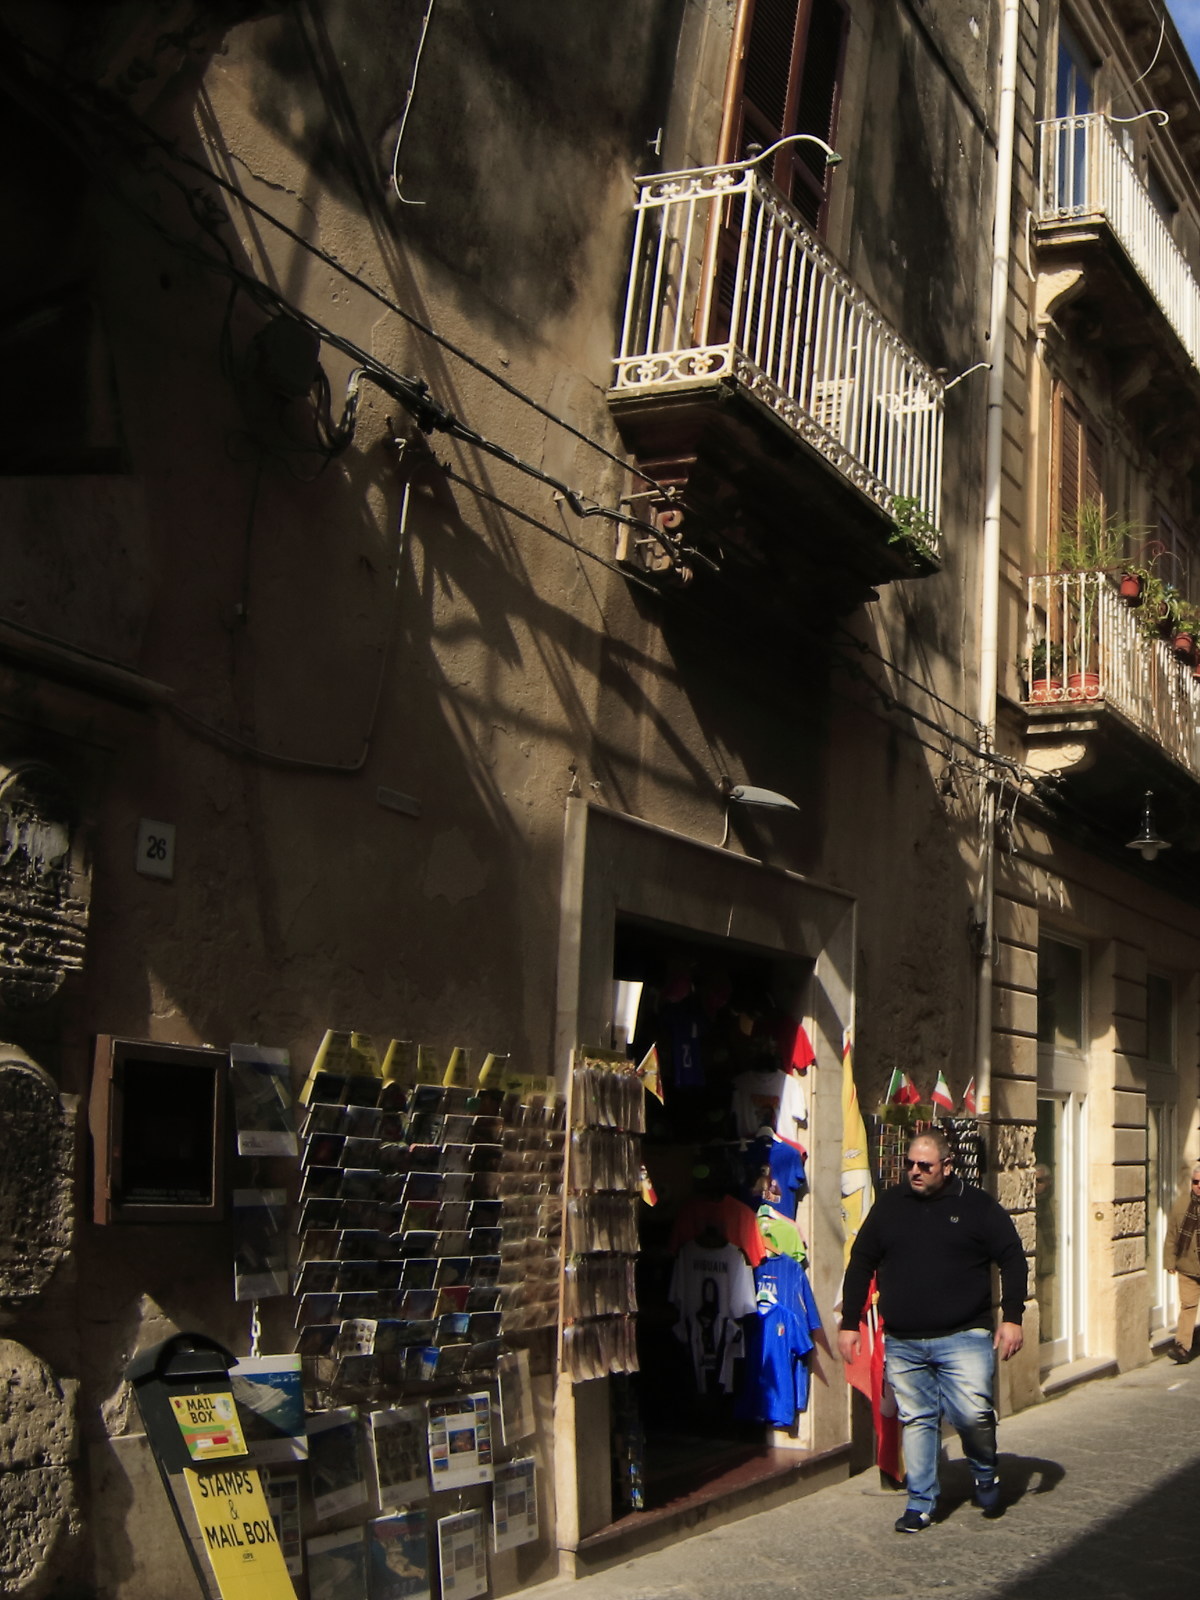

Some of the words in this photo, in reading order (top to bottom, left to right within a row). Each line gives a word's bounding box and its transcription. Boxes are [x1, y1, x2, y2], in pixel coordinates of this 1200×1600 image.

[147, 835, 166, 861] 26
[187, 1397, 216, 1411] MAIL
[190, 1411, 215, 1424] BOX
[197, 1471, 253, 1498] STAMPS
[229, 1499, 240, 1520] &
[204, 1526, 245, 1550] MAIL
[245, 1520, 276, 1545] BOX
